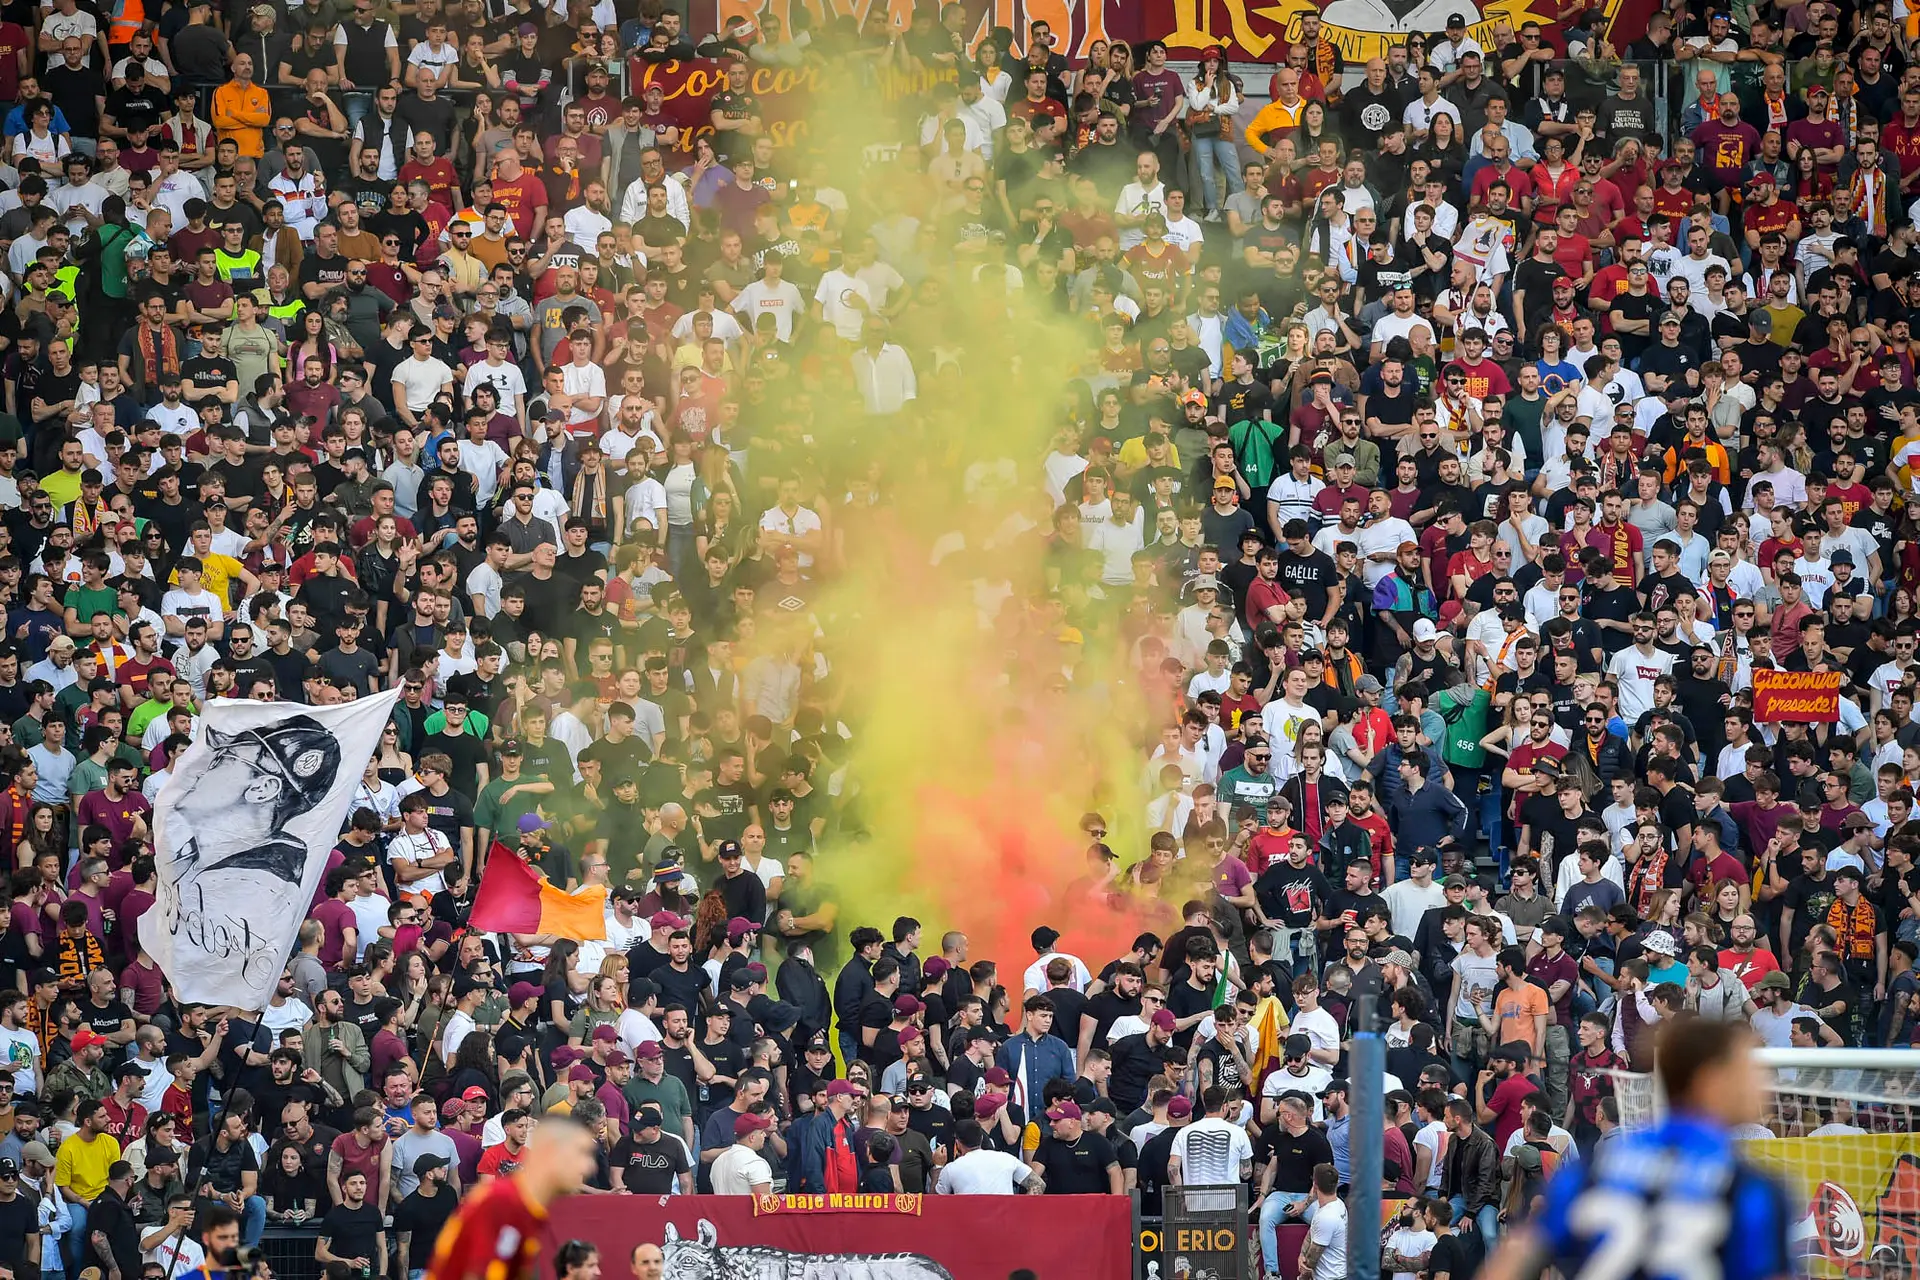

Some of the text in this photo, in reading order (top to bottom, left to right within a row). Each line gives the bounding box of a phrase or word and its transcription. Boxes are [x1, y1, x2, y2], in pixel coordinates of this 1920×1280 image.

[1611, 121, 1644, 130] TARANTINO
[1614, 116, 1641, 124] QUENTIN
[194, 371, 227, 381] ellesse
[1245, 464, 1258, 473] 44
[1285, 564, 1318, 580] GAËLLE
[1765, 695, 1838, 717] presente!
[1456, 739, 1474, 752] 456
[630, 1154, 669, 1169] FILA
[786, 1194, 824, 1210] Daje
[830, 1193, 889, 1209] Mauro!
